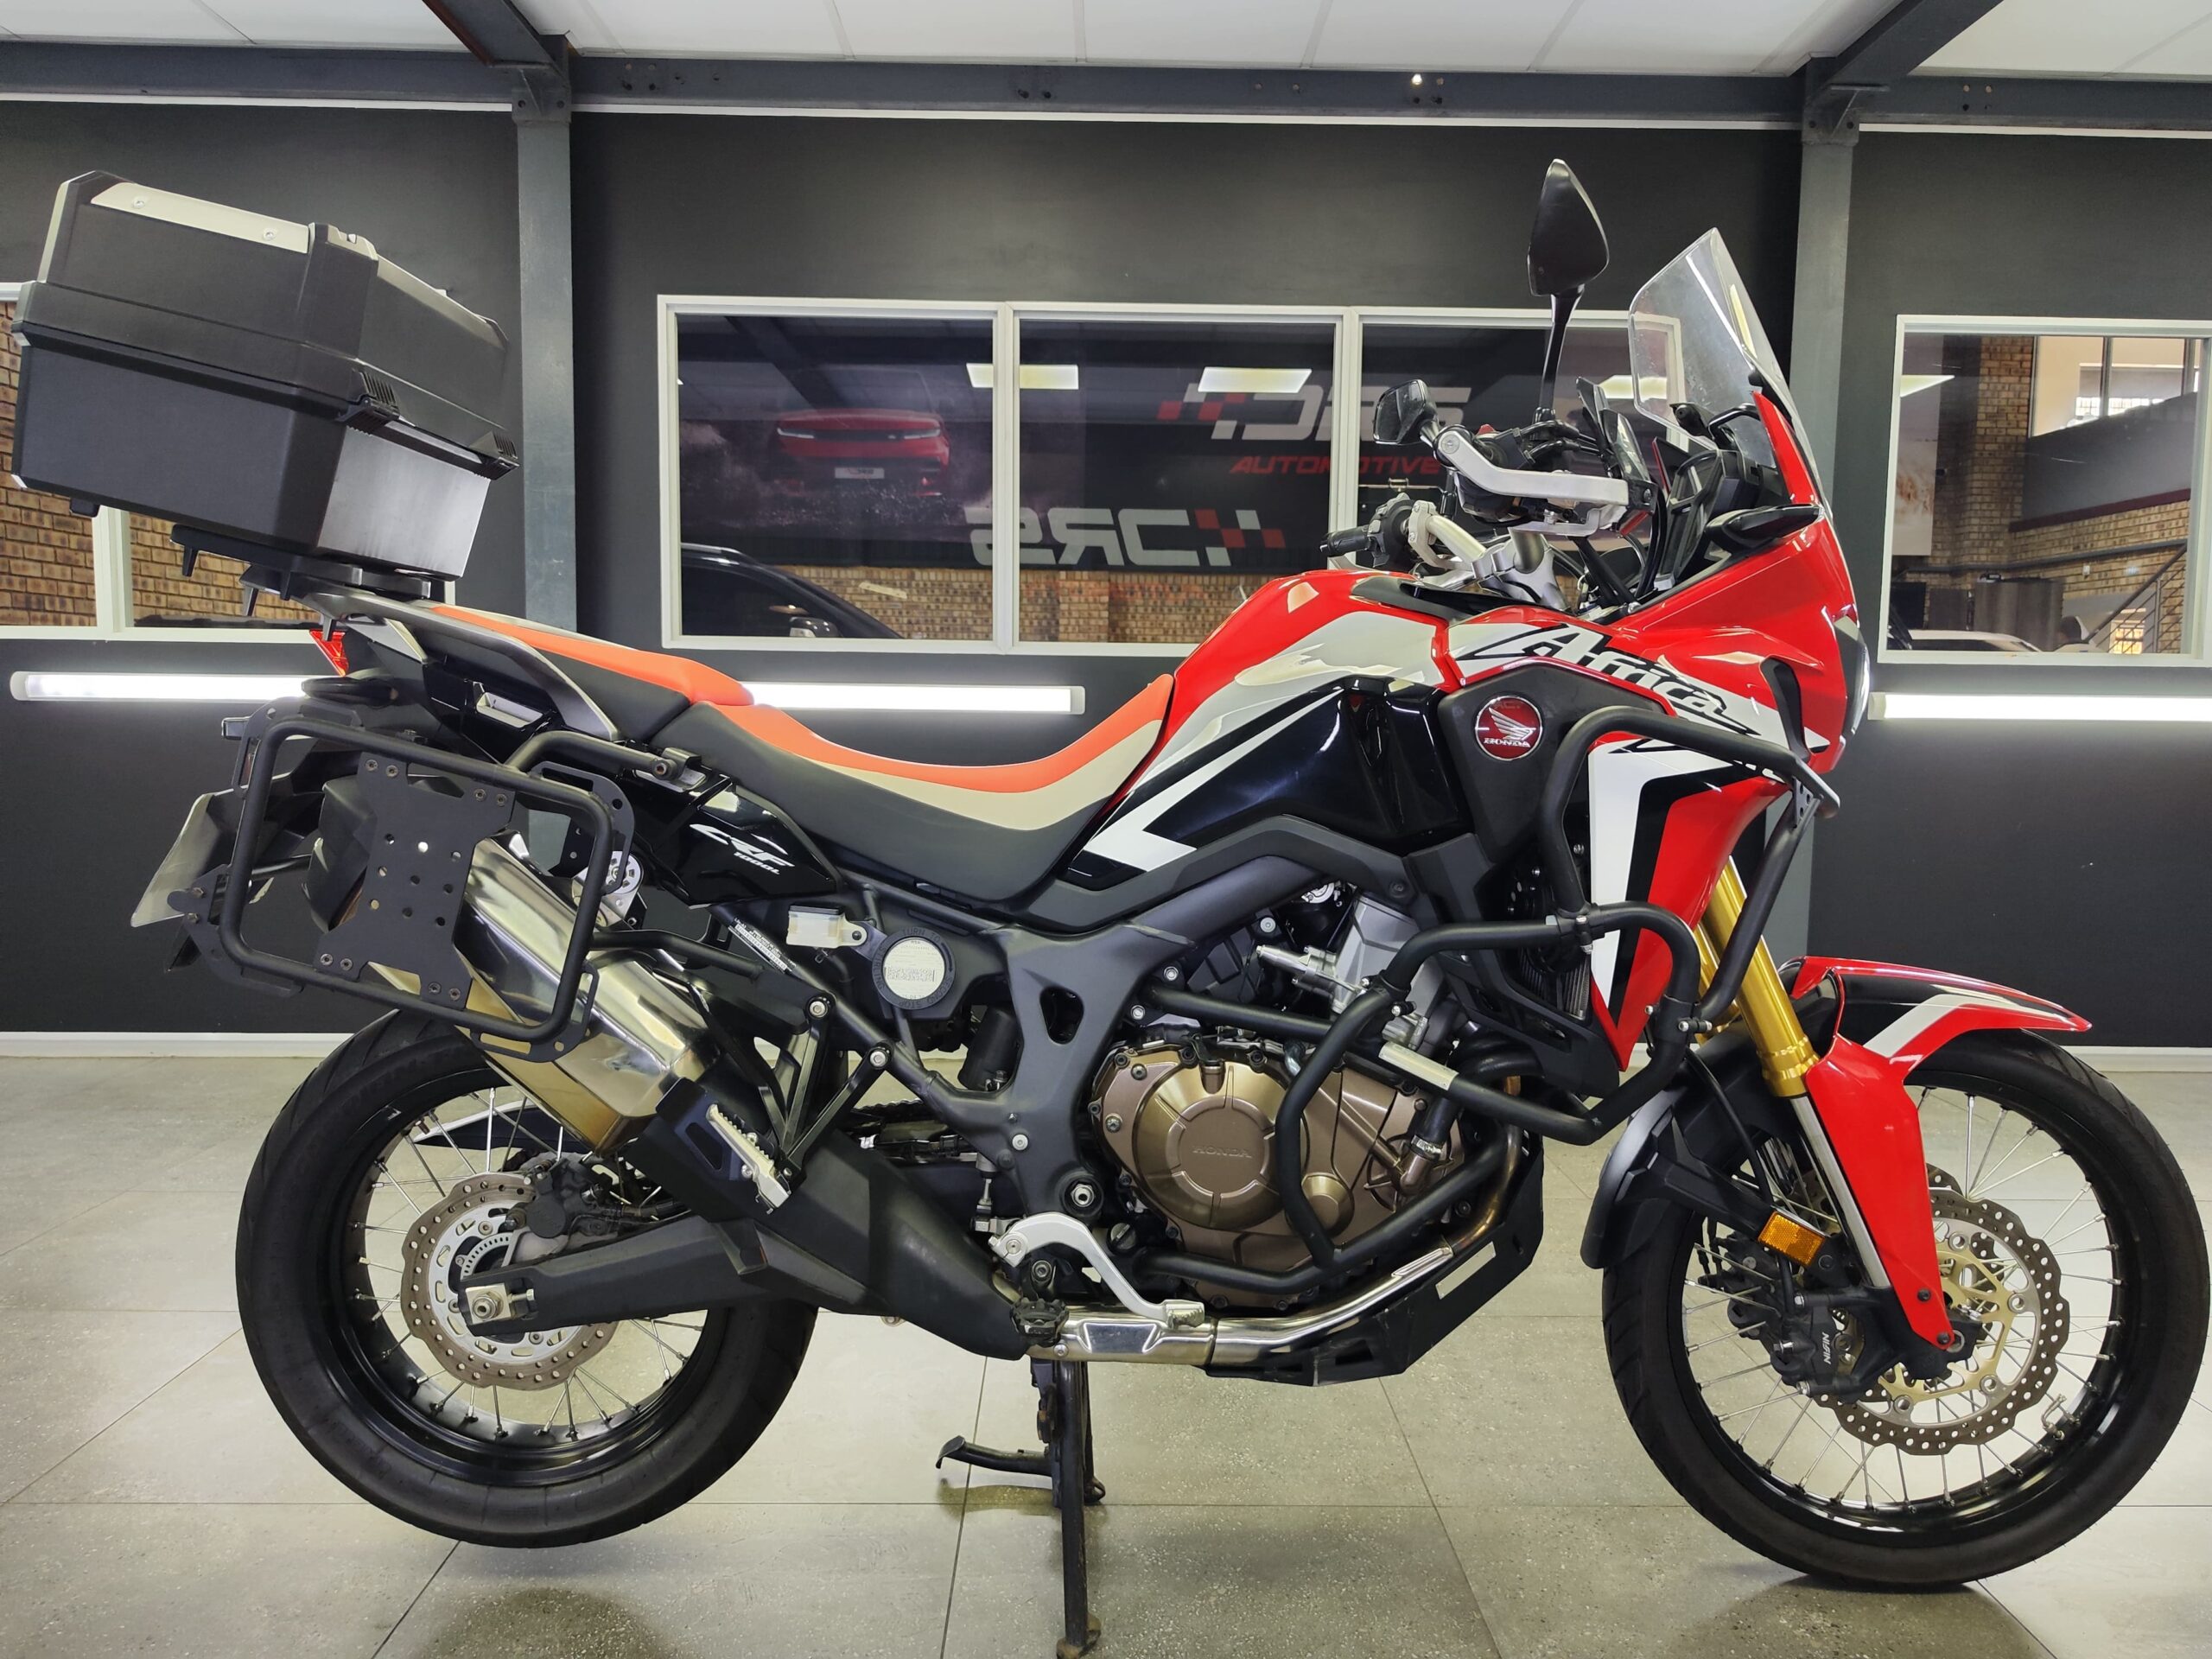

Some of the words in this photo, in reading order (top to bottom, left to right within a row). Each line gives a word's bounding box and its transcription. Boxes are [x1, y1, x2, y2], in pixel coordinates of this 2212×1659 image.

[1457, 624, 1761, 735] Africa
[1484, 738, 1530, 748] HONDA
[1192, 1146, 1252, 1159] HONDA
